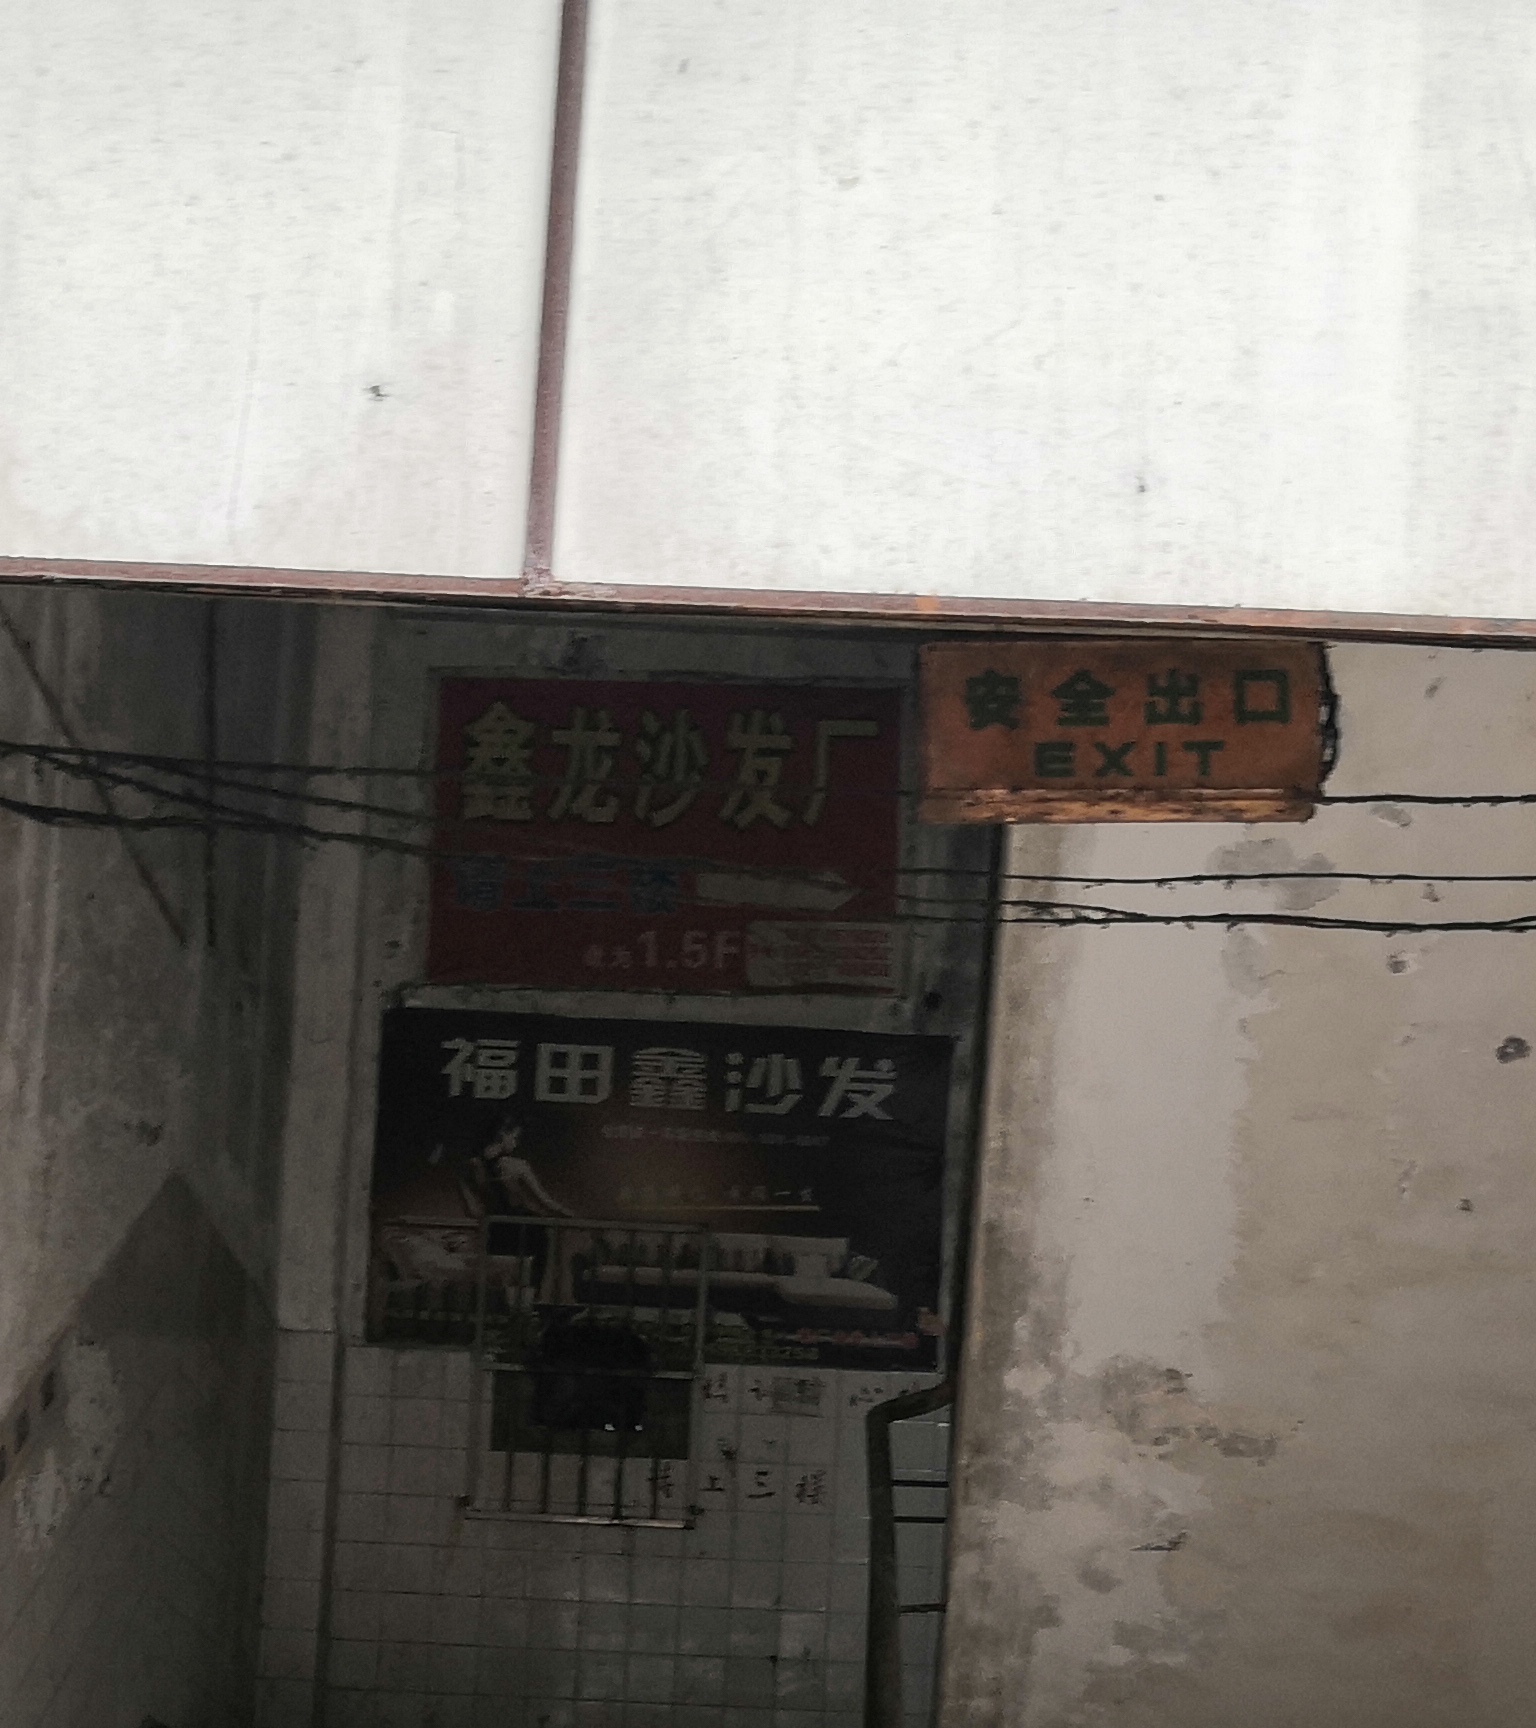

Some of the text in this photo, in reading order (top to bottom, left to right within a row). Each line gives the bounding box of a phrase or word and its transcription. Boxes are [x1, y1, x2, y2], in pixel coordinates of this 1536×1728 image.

[964, 667, 1293, 731] 安全出口
[462, 698, 881, 830] 鑫龙沙发厂
[1033, 739, 1226, 779] EXIT
[439, 1036, 900, 1122] 福田鑫沙发
